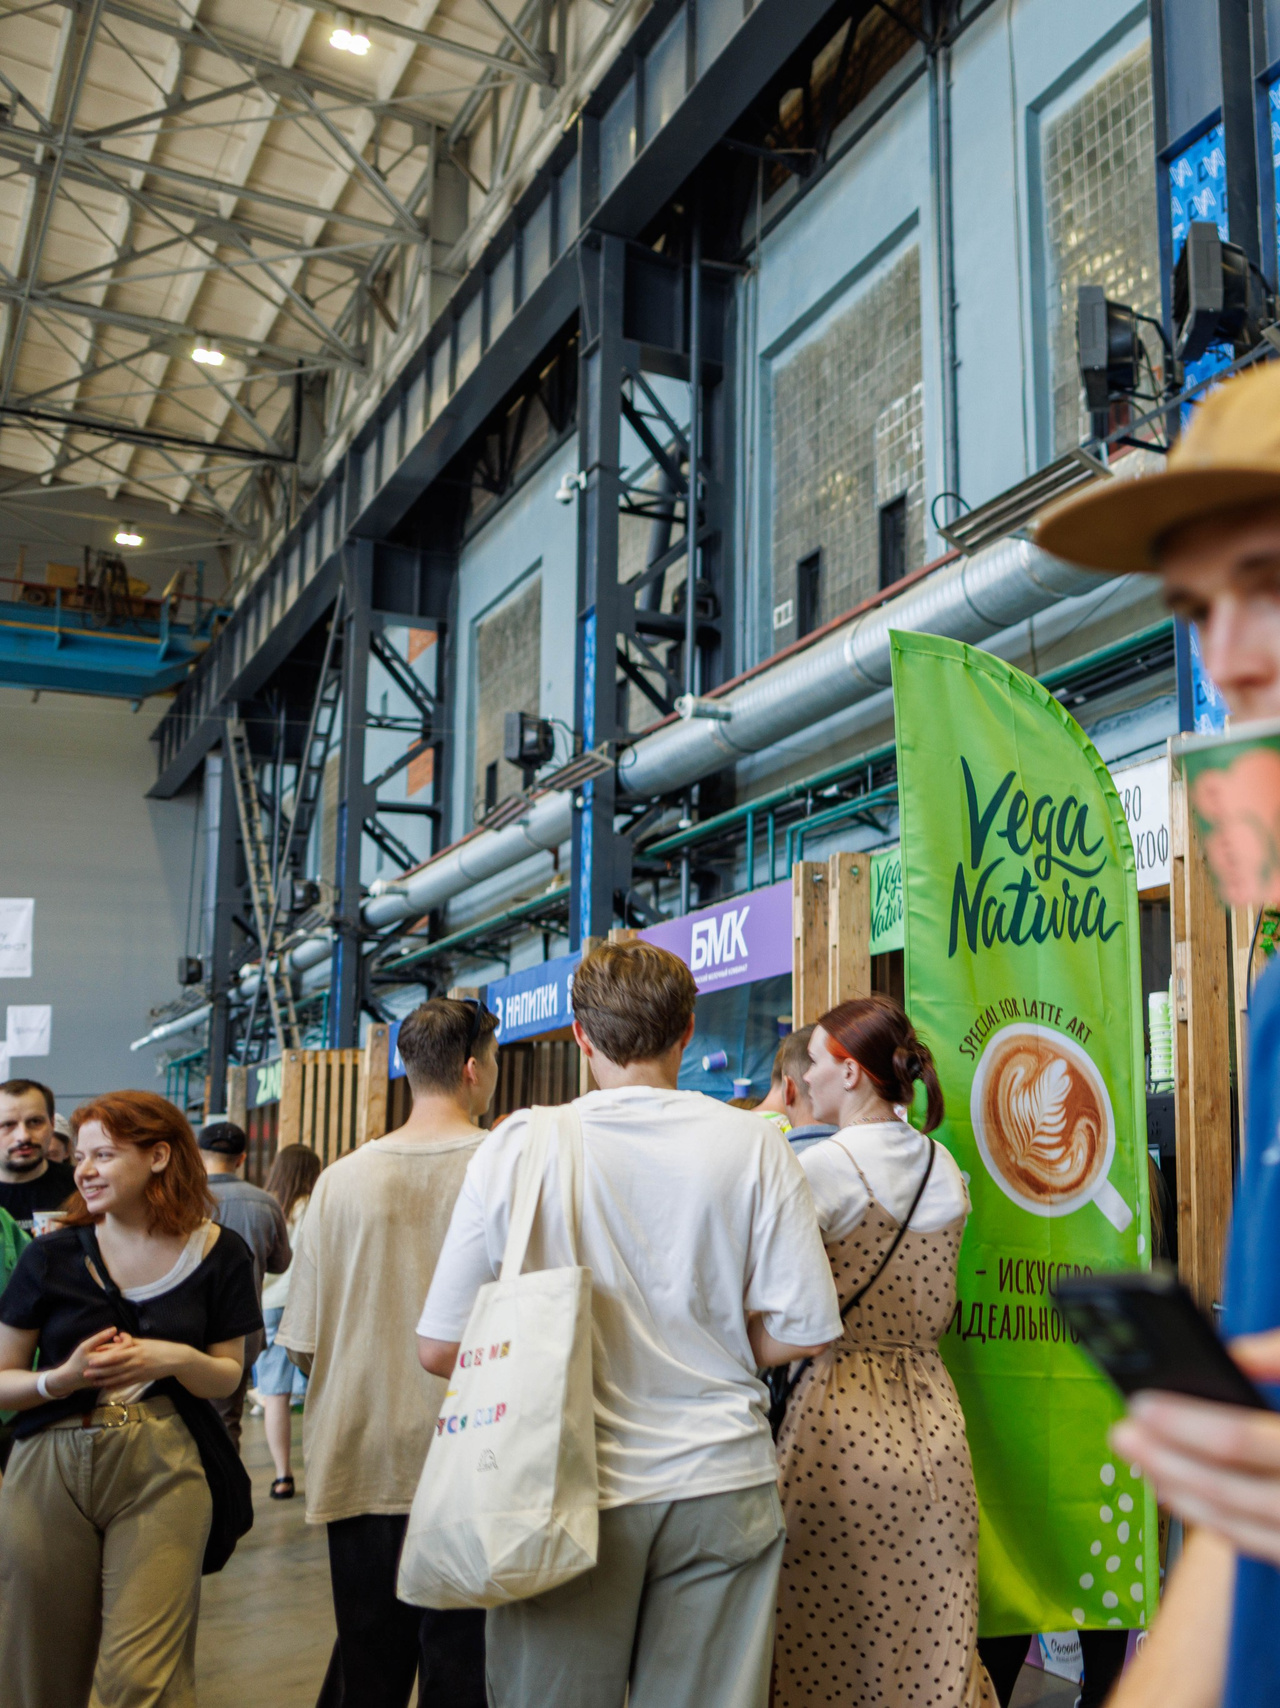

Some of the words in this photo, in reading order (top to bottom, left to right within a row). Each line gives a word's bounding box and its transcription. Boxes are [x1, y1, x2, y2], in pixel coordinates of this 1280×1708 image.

[960, 755, 1107, 881] Vega
[691, 905, 750, 972] БМК
[948, 857, 1124, 959] Natura
[505, 981, 558, 1030] НАПИТКИ
[959, 1005, 1000, 1061] SPECIAL
[999, 997, 1020, 1019] FOR
[1023, 997, 1063, 1026] LATTE
[1066, 1016, 1092, 1044] ART
